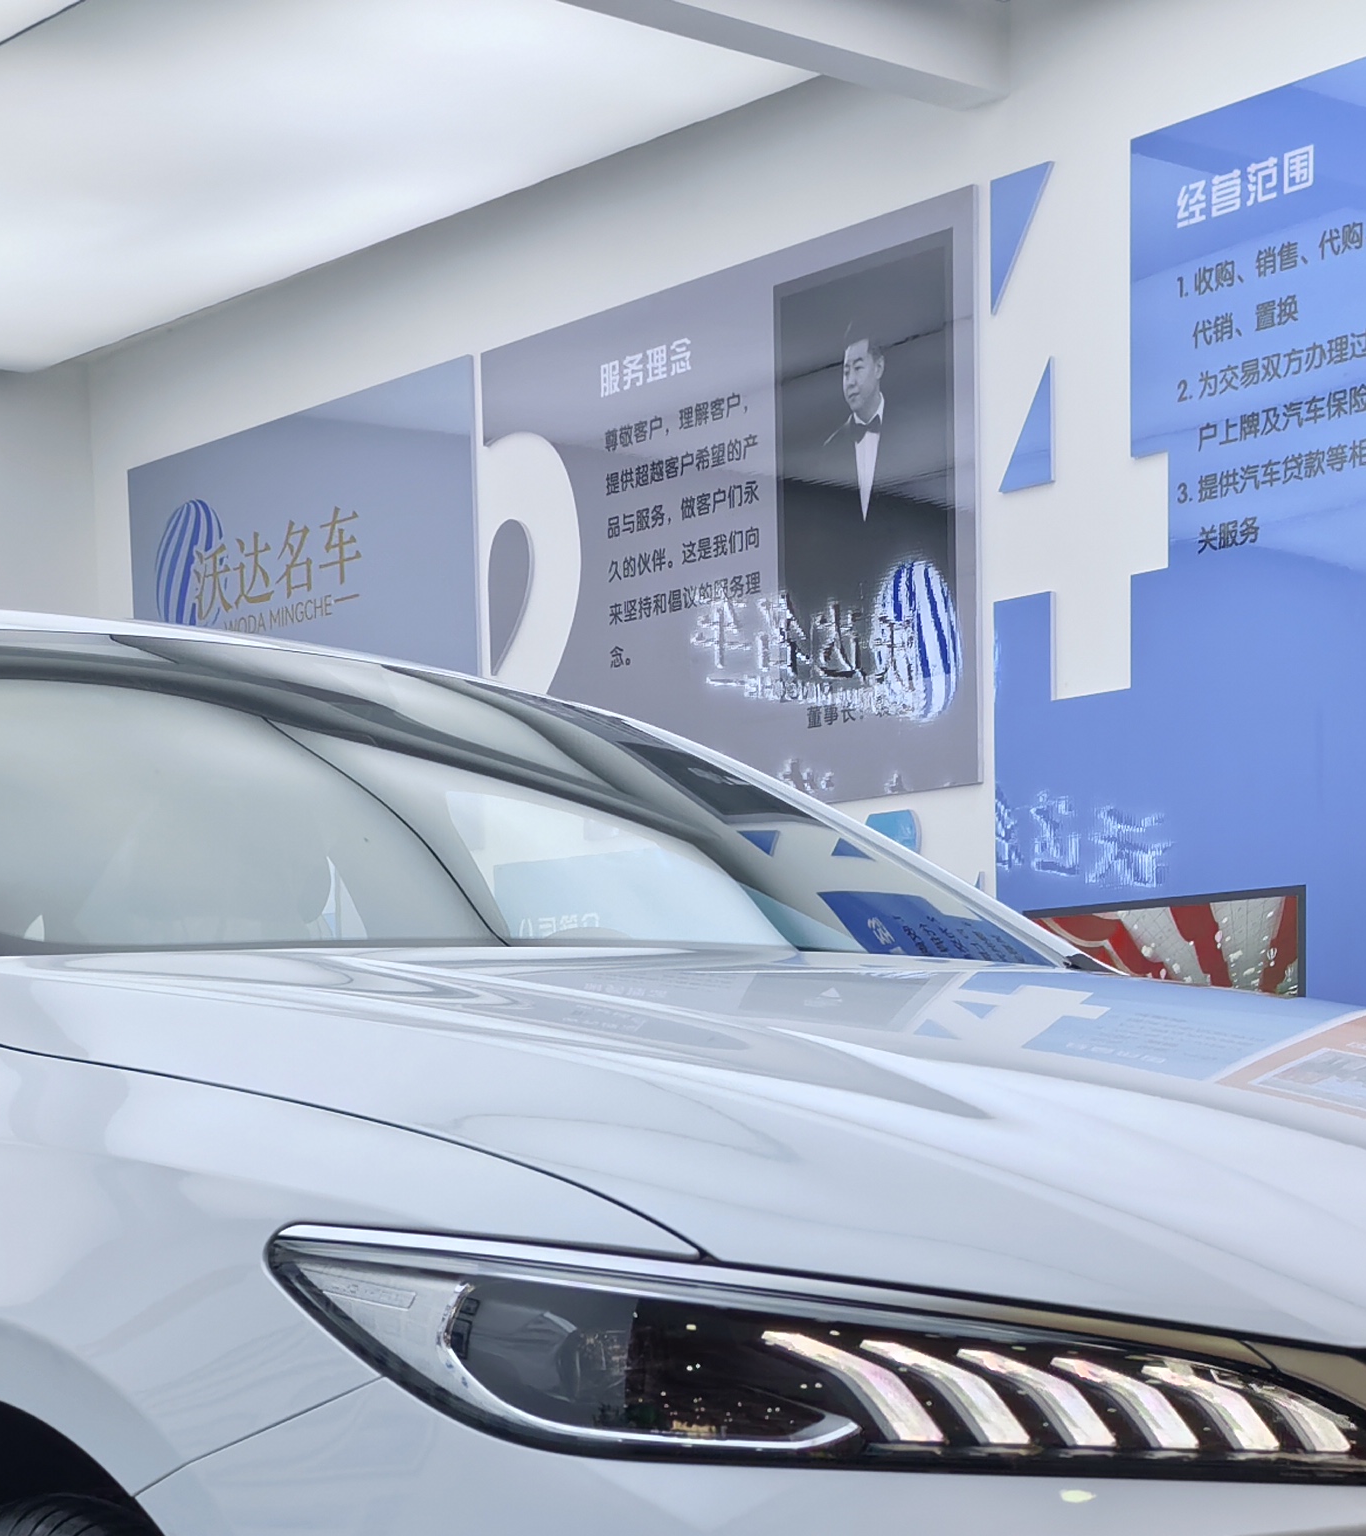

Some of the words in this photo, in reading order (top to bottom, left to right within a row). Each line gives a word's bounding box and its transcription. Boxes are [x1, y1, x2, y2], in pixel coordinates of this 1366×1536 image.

[1176, 144, 1315, 229] 经营范围
[600, 337, 693, 399] 服务理念
[605, 433, 760, 497] 提供超越客户希望的产
[193, 506, 363, 621] 沃达名车
[1197, 516, 1260, 555] 关服务
[269, 594, 334, 631] MINGCHE
[609, 571, 762, 627] 来坚持和倡议的服务理
